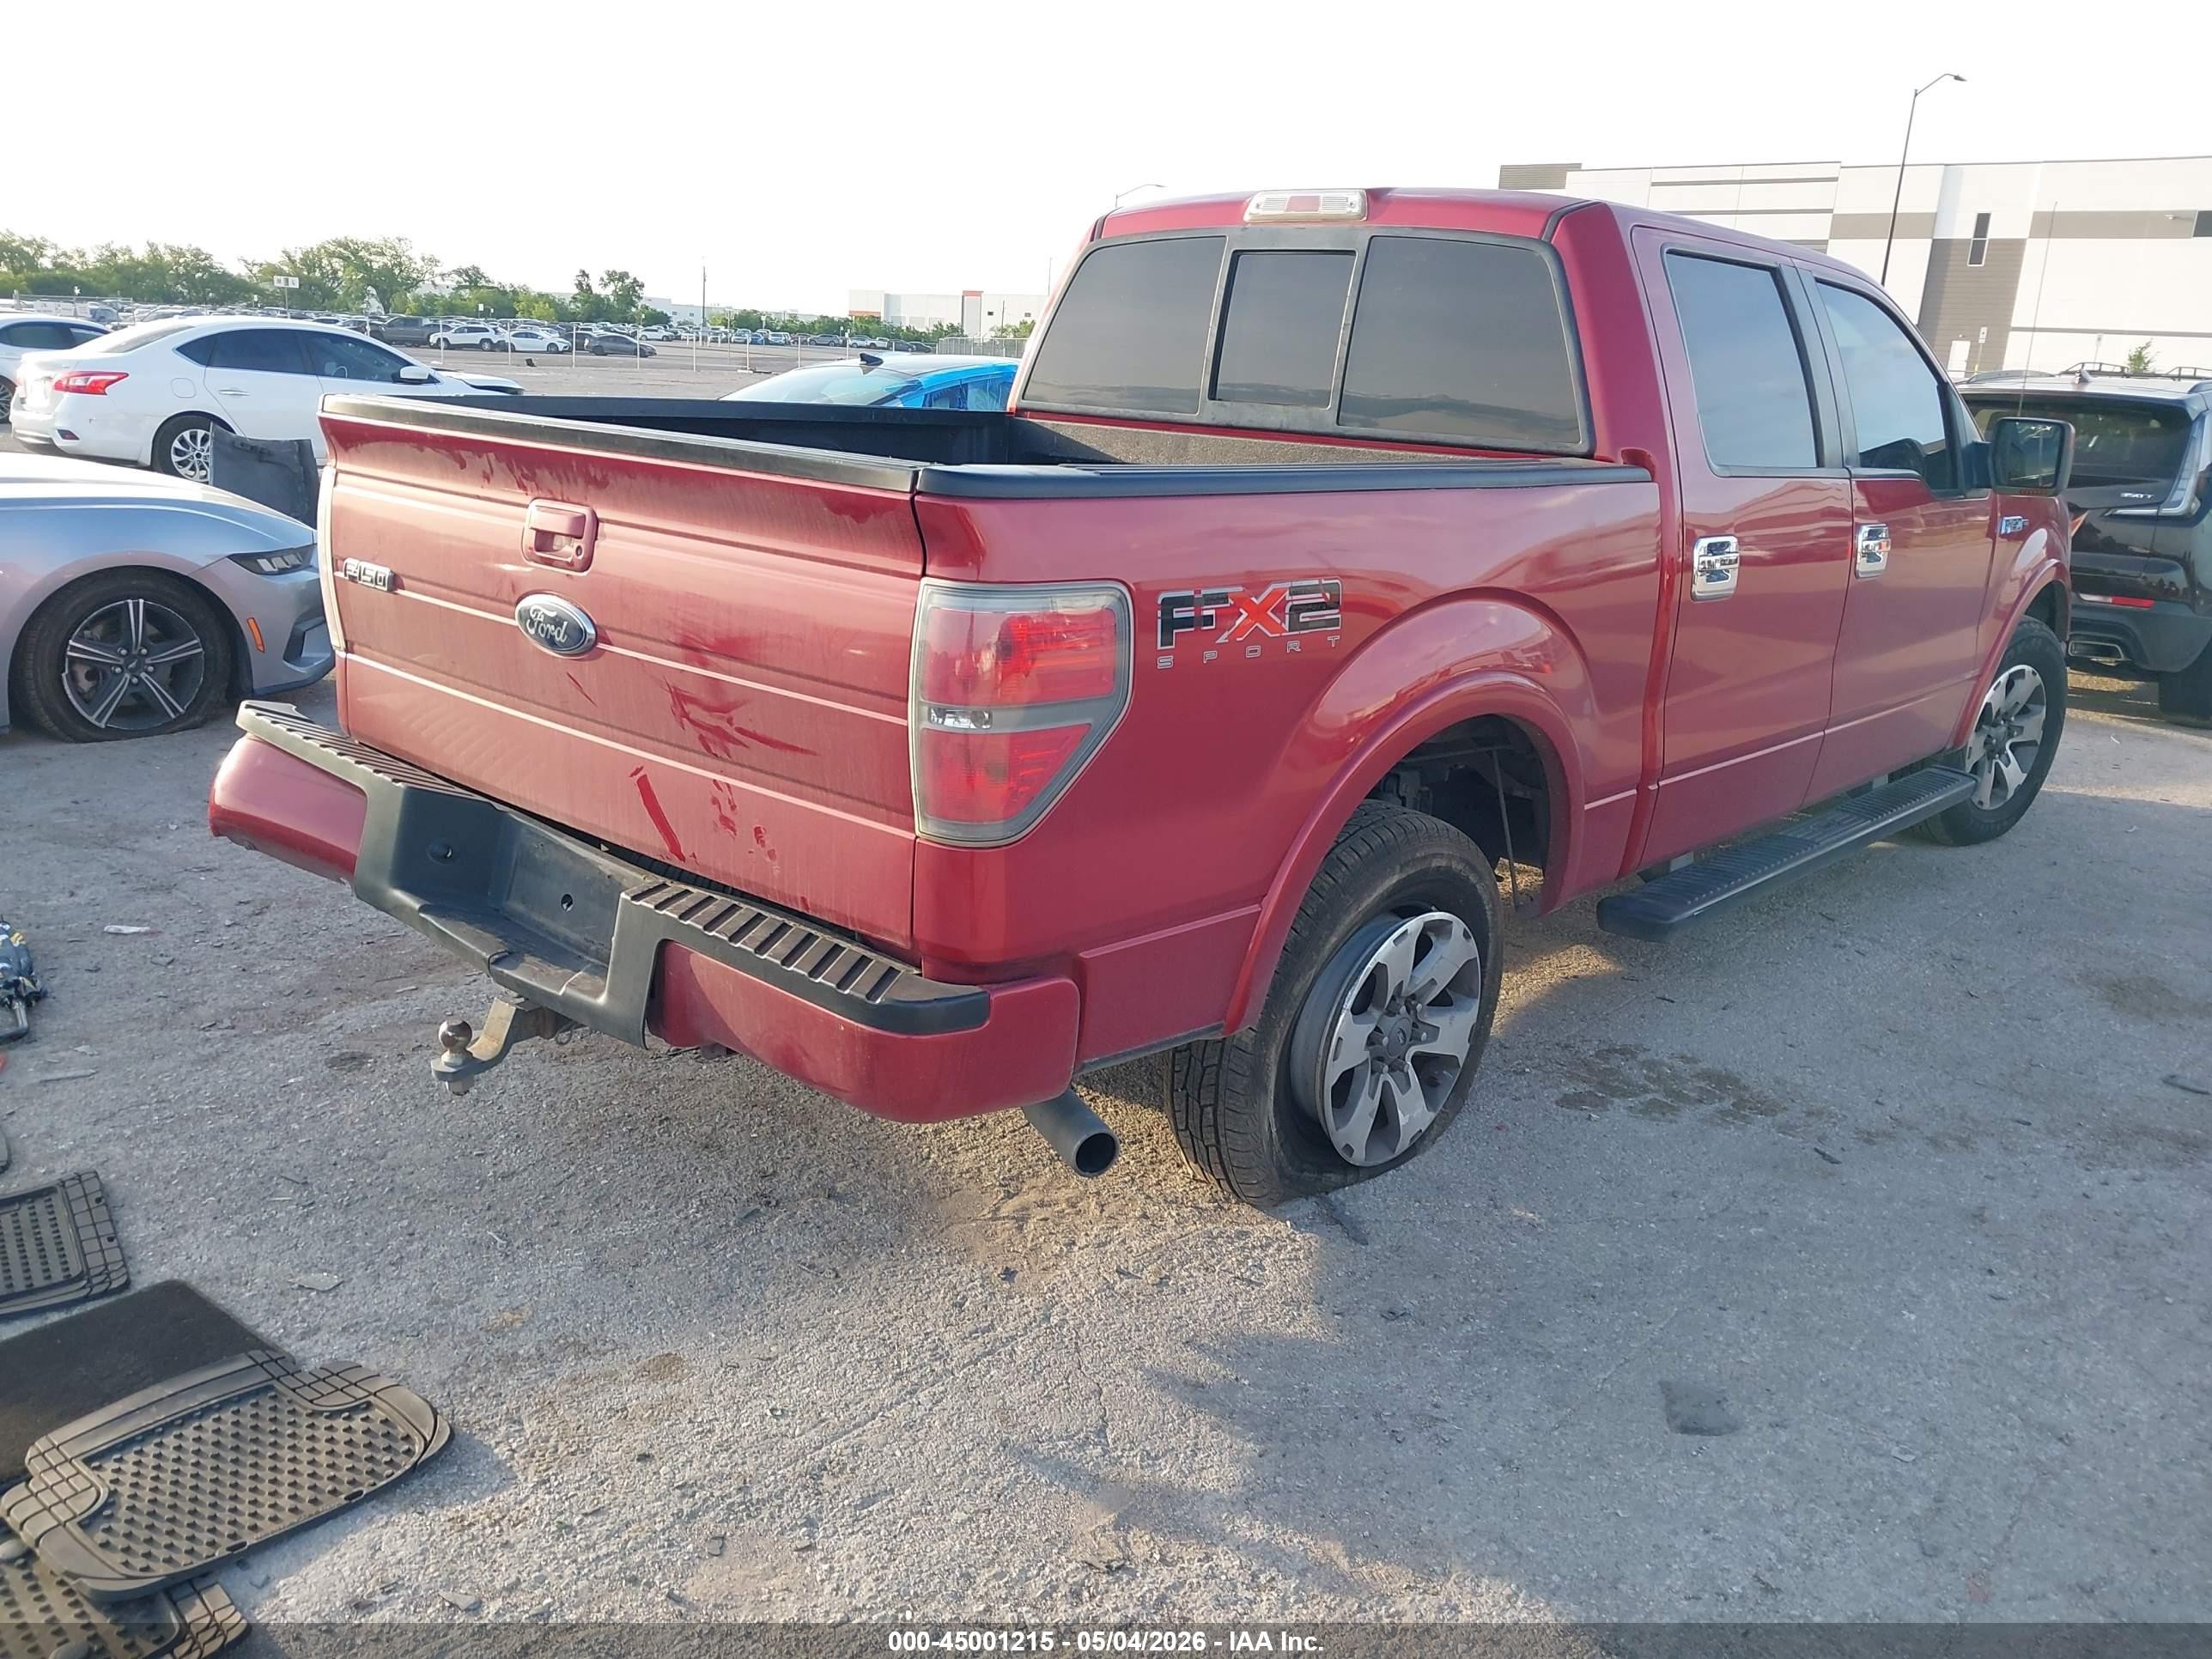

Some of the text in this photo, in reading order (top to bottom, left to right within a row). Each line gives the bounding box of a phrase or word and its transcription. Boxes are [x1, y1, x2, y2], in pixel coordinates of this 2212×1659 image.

[526, 604, 568, 643] Ford
[1158, 576, 1342, 650] FX2
[1157, 635, 1340, 670] SPORT
